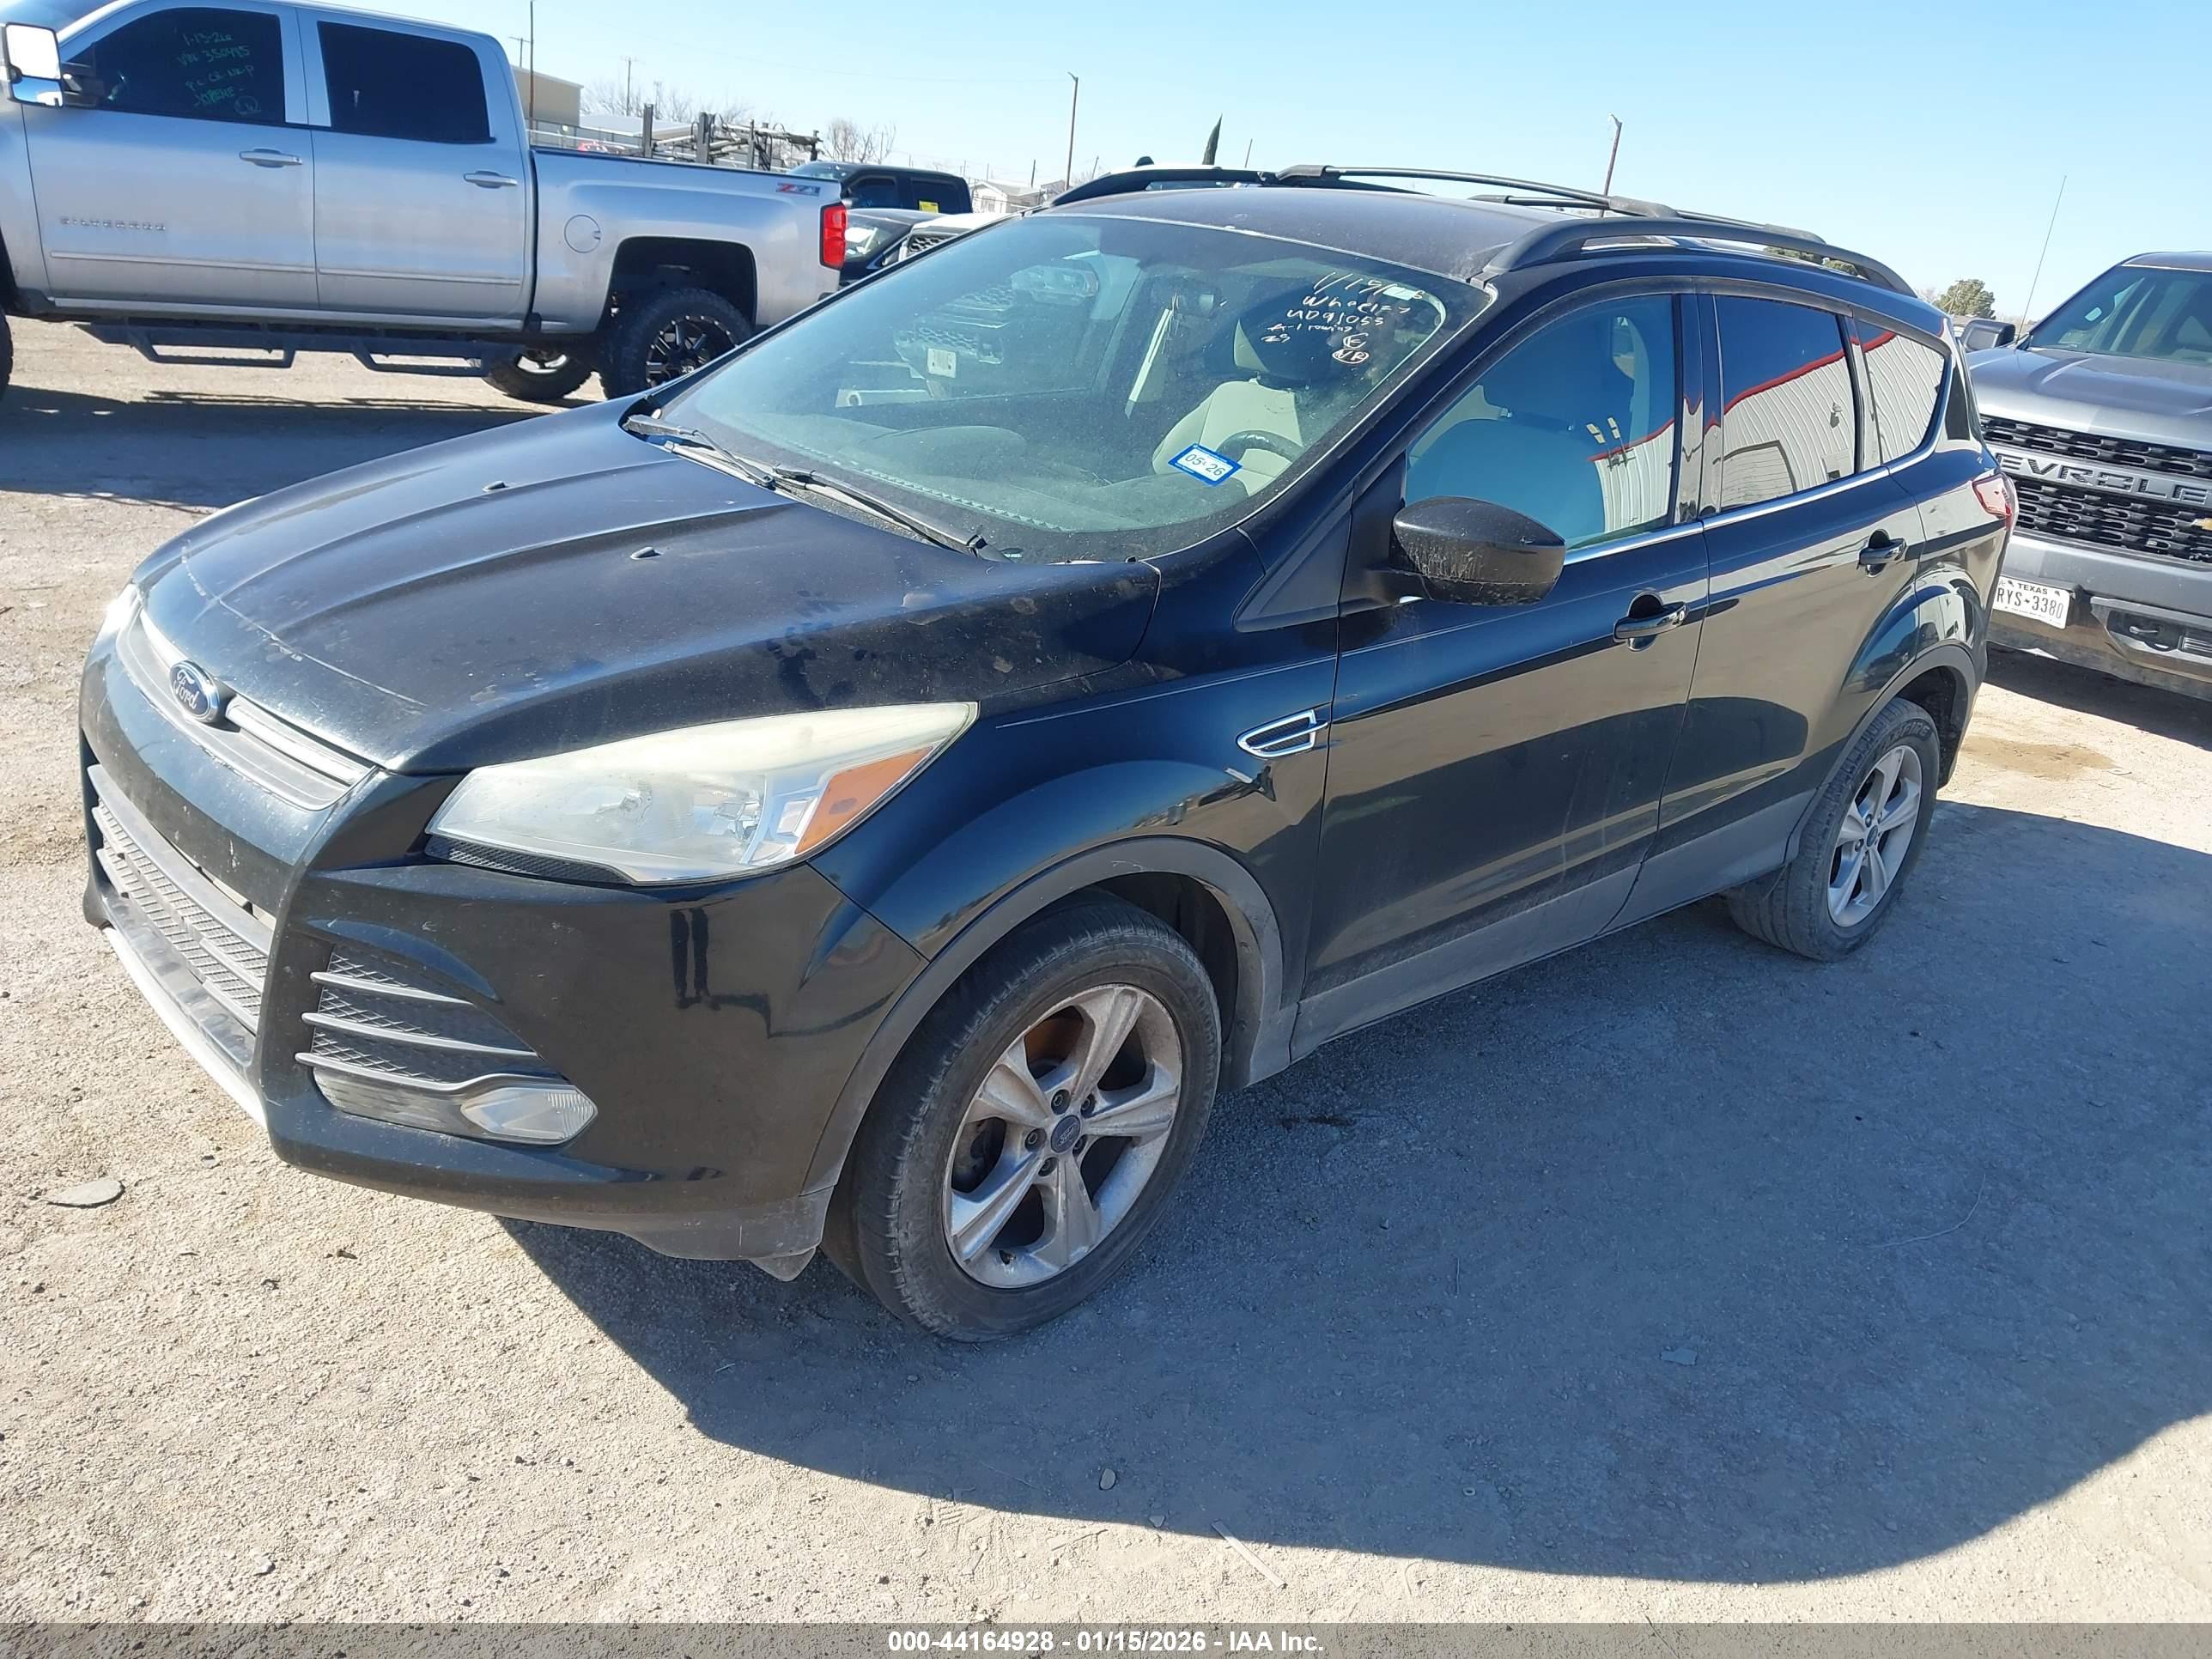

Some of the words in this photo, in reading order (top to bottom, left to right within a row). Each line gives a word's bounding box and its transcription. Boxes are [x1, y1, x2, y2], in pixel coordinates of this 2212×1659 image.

[1205, 463, 1226, 477] 26
[2016, 582, 2048, 595] TEXAS
[173, 669, 200, 710] Ford
